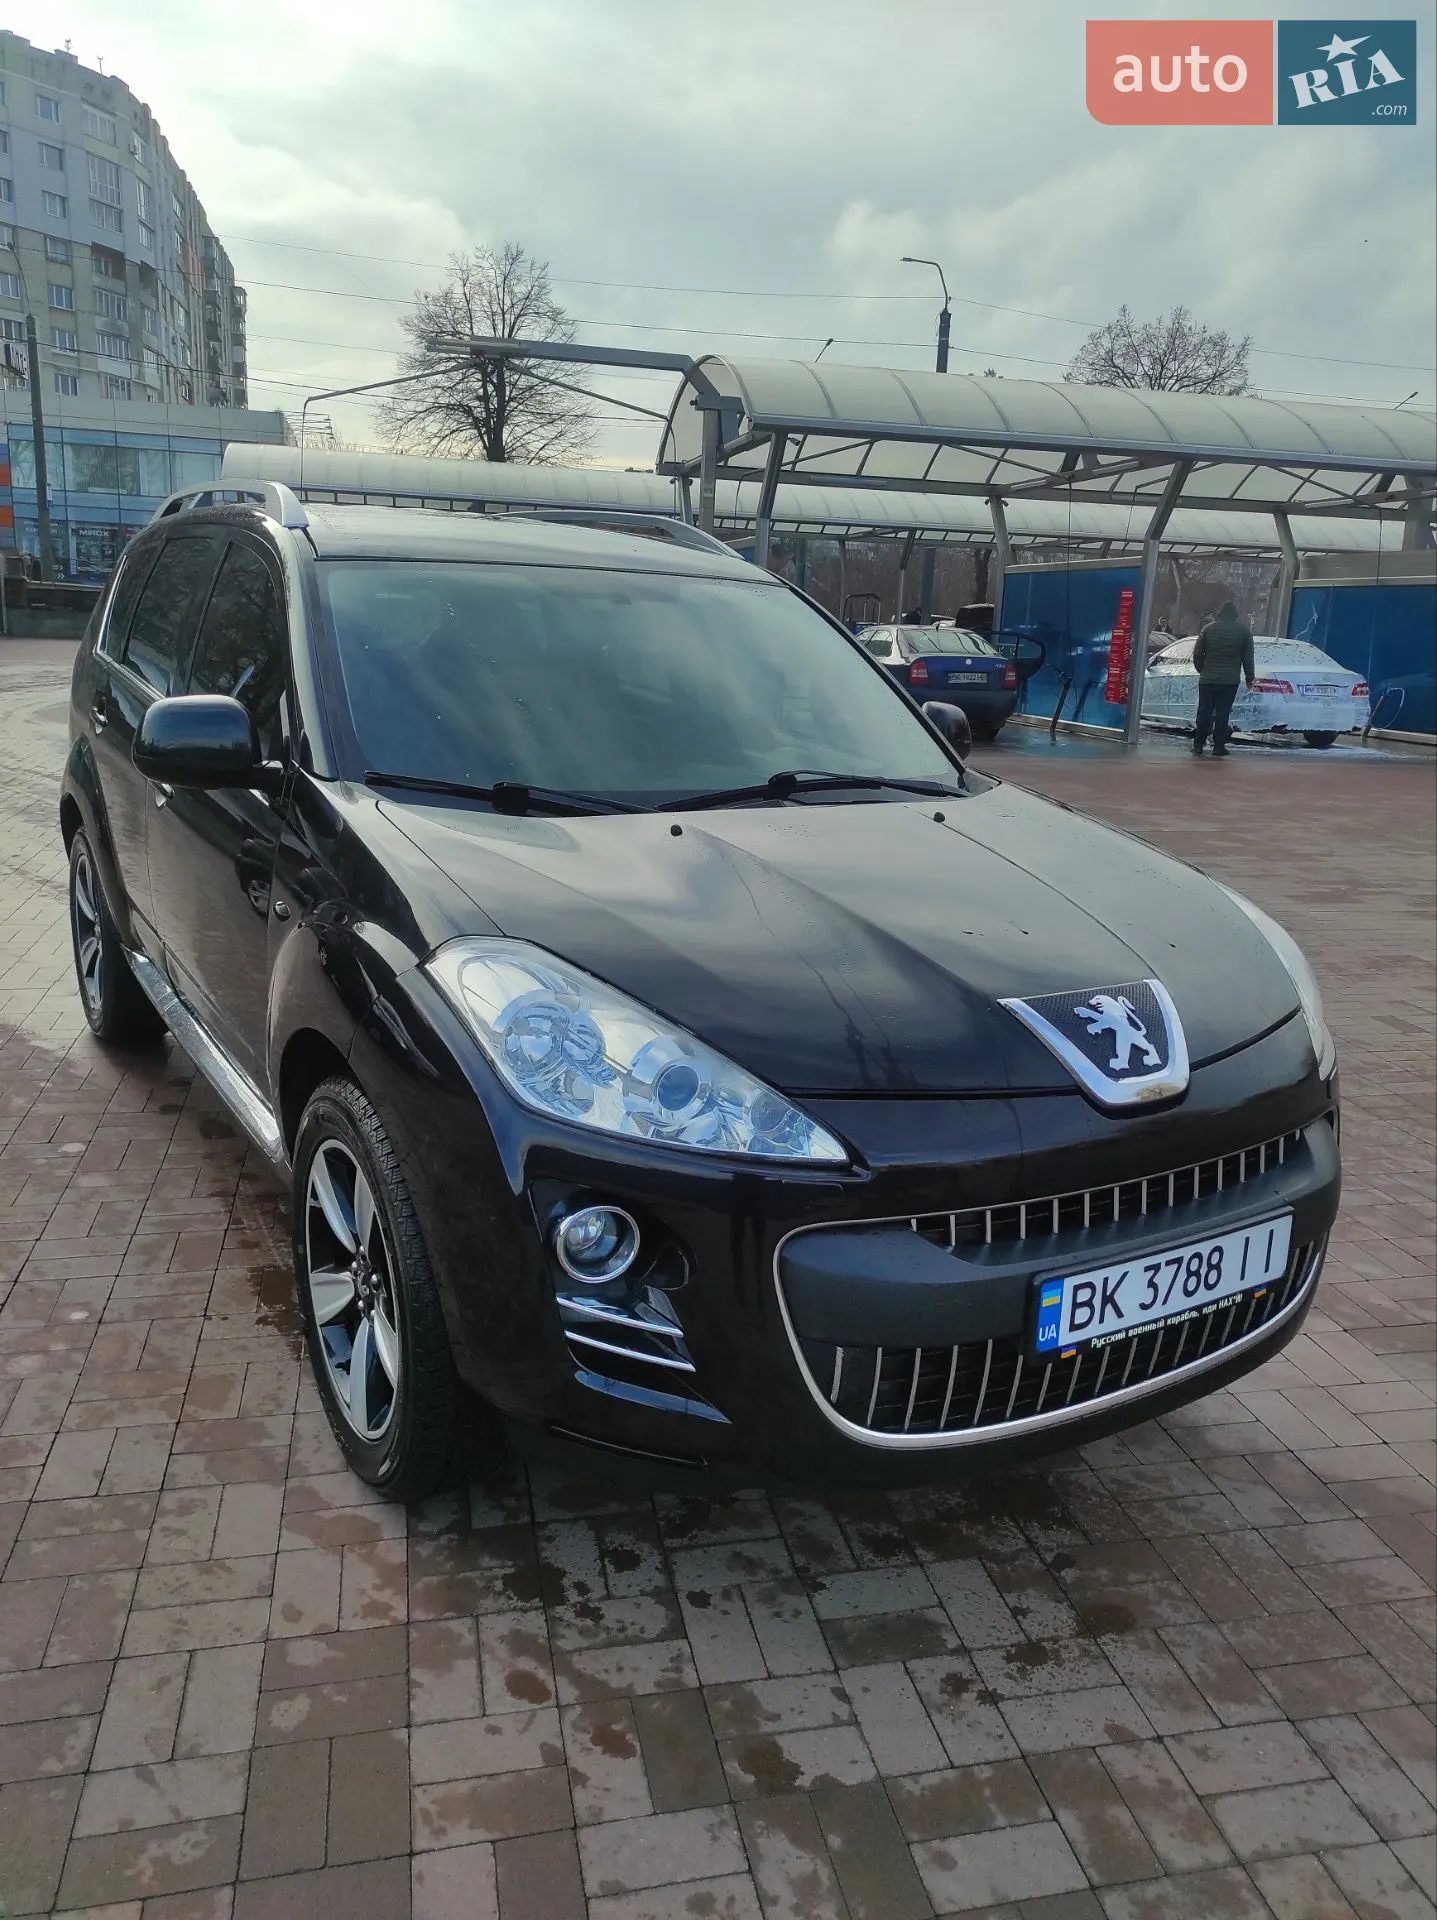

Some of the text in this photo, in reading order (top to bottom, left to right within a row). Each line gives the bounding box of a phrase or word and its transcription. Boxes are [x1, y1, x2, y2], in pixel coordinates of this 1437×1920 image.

[1068, 1270, 1130, 1333] BK
[1138, 1245, 1224, 1311] 3788
[1038, 1323, 1057, 1342] UA
[1091, 1331, 1126, 1349] Русский
[1128, 1318, 1165, 1338] военный
[1167, 1309, 1200, 1326] корабль,
[1202, 1303, 1217, 1316] иди
